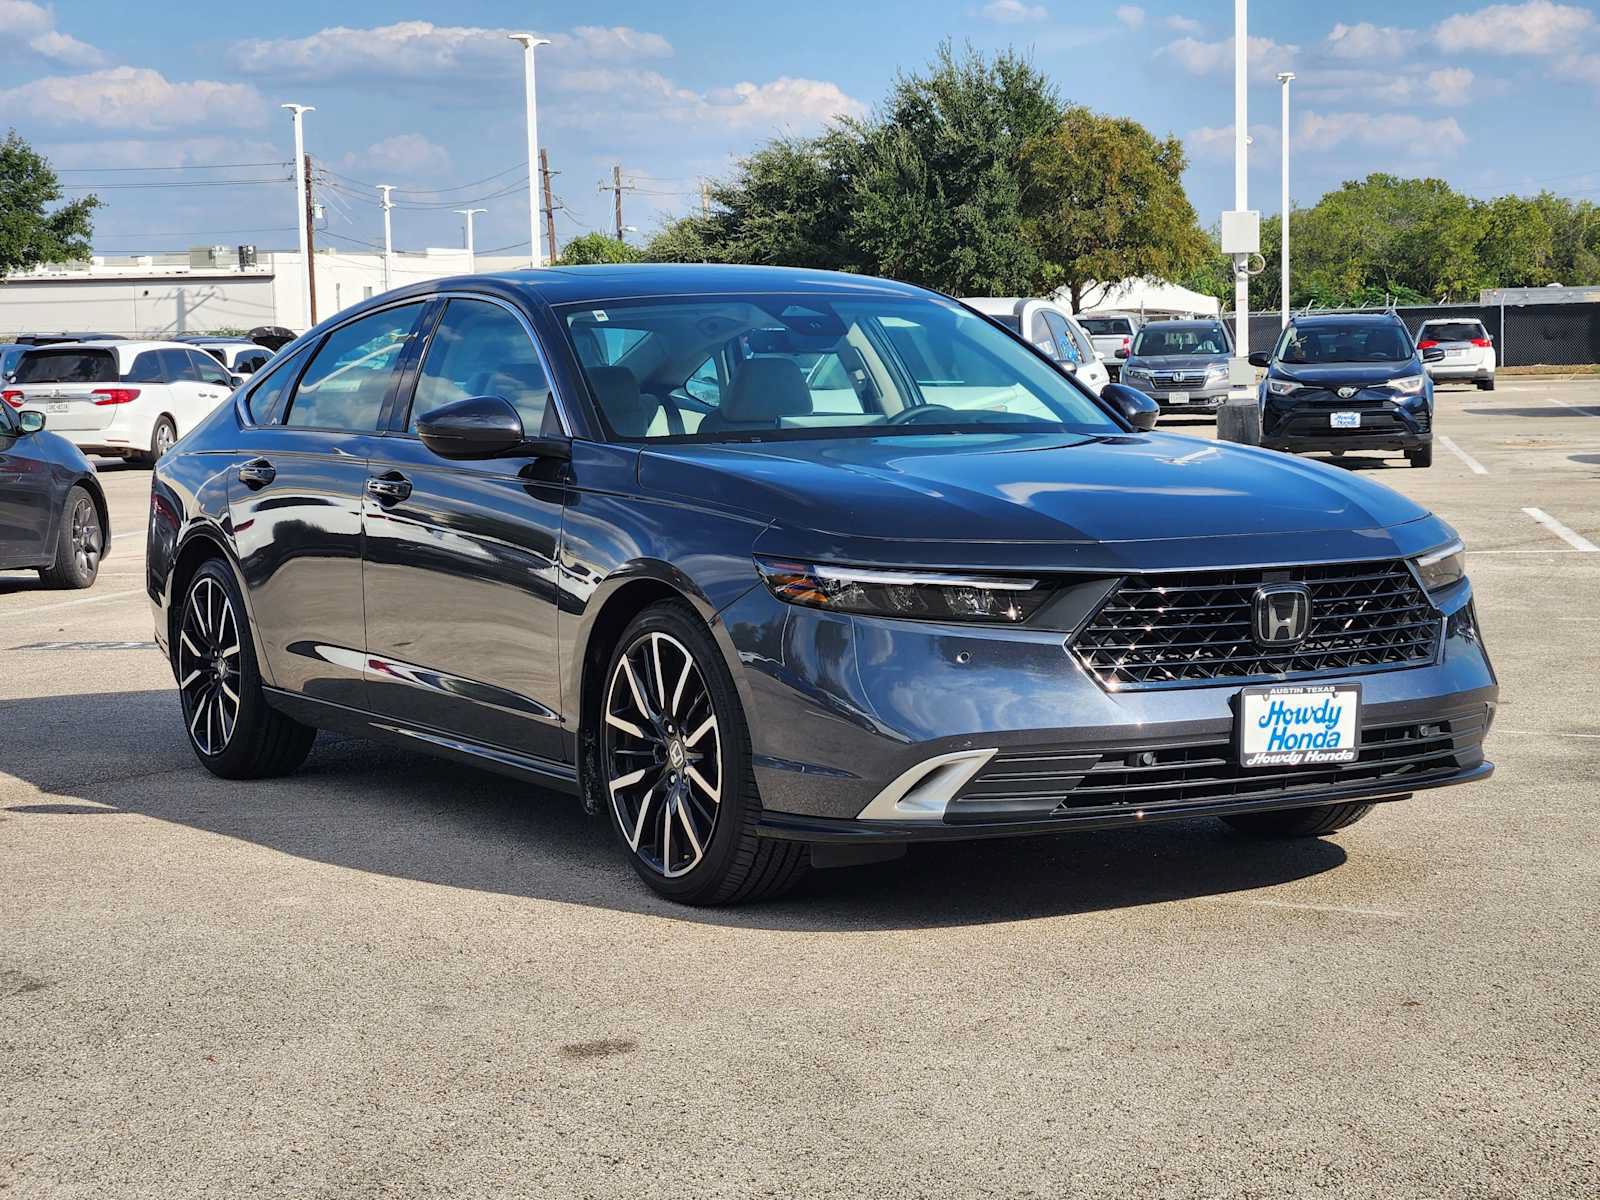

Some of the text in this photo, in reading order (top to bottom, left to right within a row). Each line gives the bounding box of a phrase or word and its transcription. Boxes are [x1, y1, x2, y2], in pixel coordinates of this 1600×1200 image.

[1258, 699, 1342, 729] Howdy
[1267, 726, 1341, 751] Honda
[1246, 749, 1354, 765] Howdy Honda
